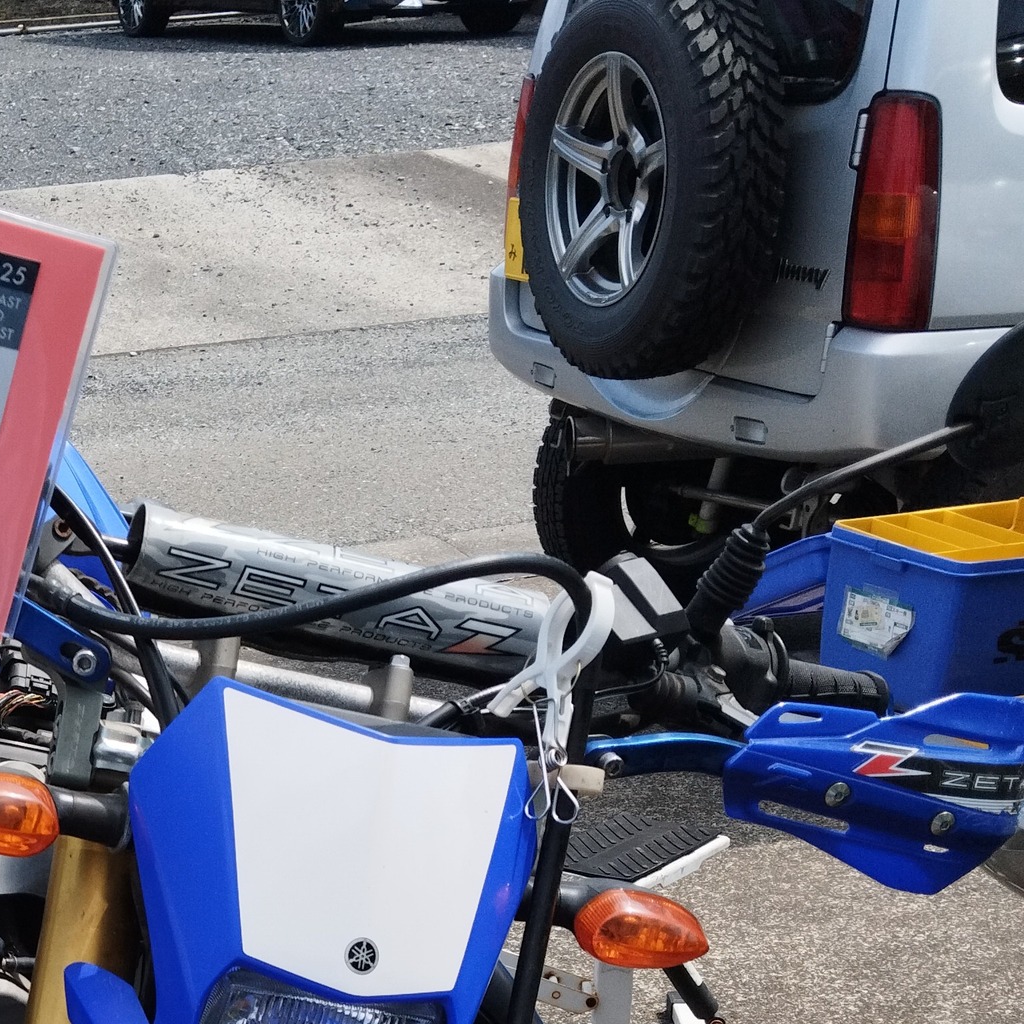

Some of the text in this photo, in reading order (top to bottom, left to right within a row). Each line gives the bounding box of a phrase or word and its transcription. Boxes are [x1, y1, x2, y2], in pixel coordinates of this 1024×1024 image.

[150, 577, 192, 597] HIGH
[338, 625, 432, 651] PRODUCTS
[257, 547, 297, 564] HIGH
[444, 591, 534, 618] PRODUCTS
[939, 769, 1024, 792] ZET
